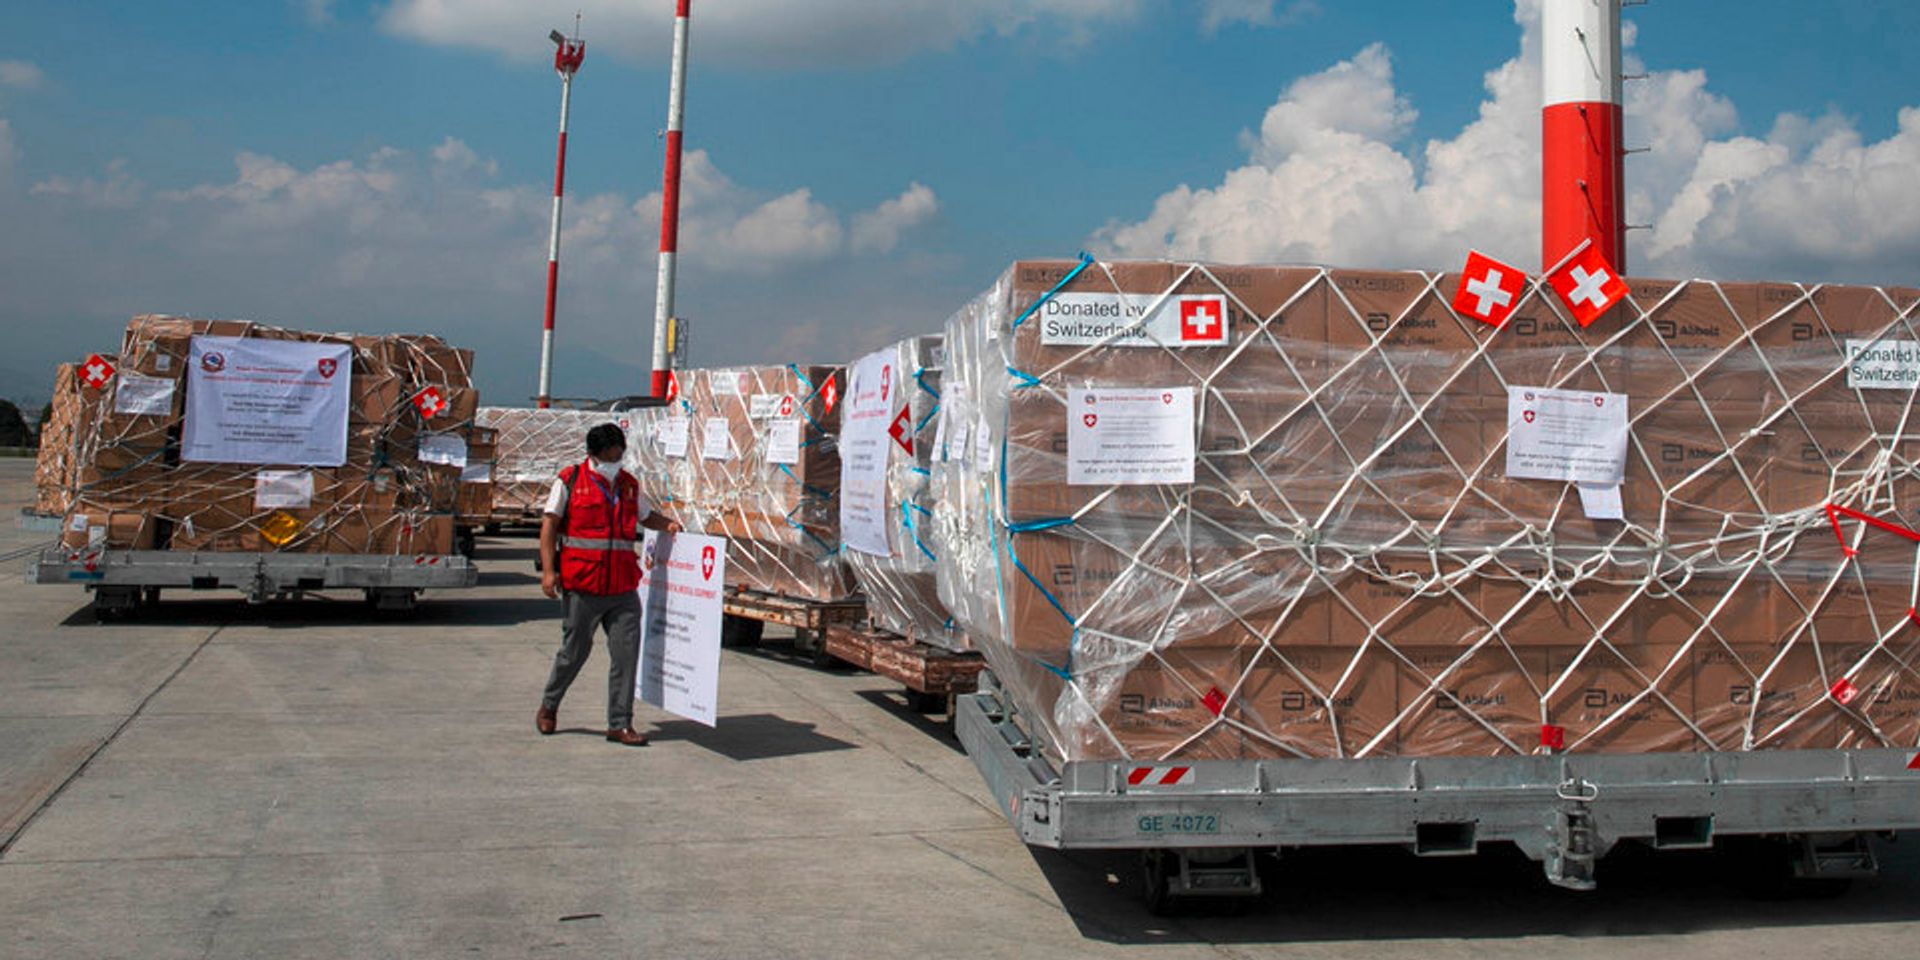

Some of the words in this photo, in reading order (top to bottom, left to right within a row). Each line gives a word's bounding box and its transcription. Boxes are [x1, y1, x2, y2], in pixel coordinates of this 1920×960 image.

[1047, 300, 1120, 317] Donated
[1852, 347, 1913, 362] Donated
[1138, 815, 1163, 832] GE
[1171, 815, 1216, 832] 4072
